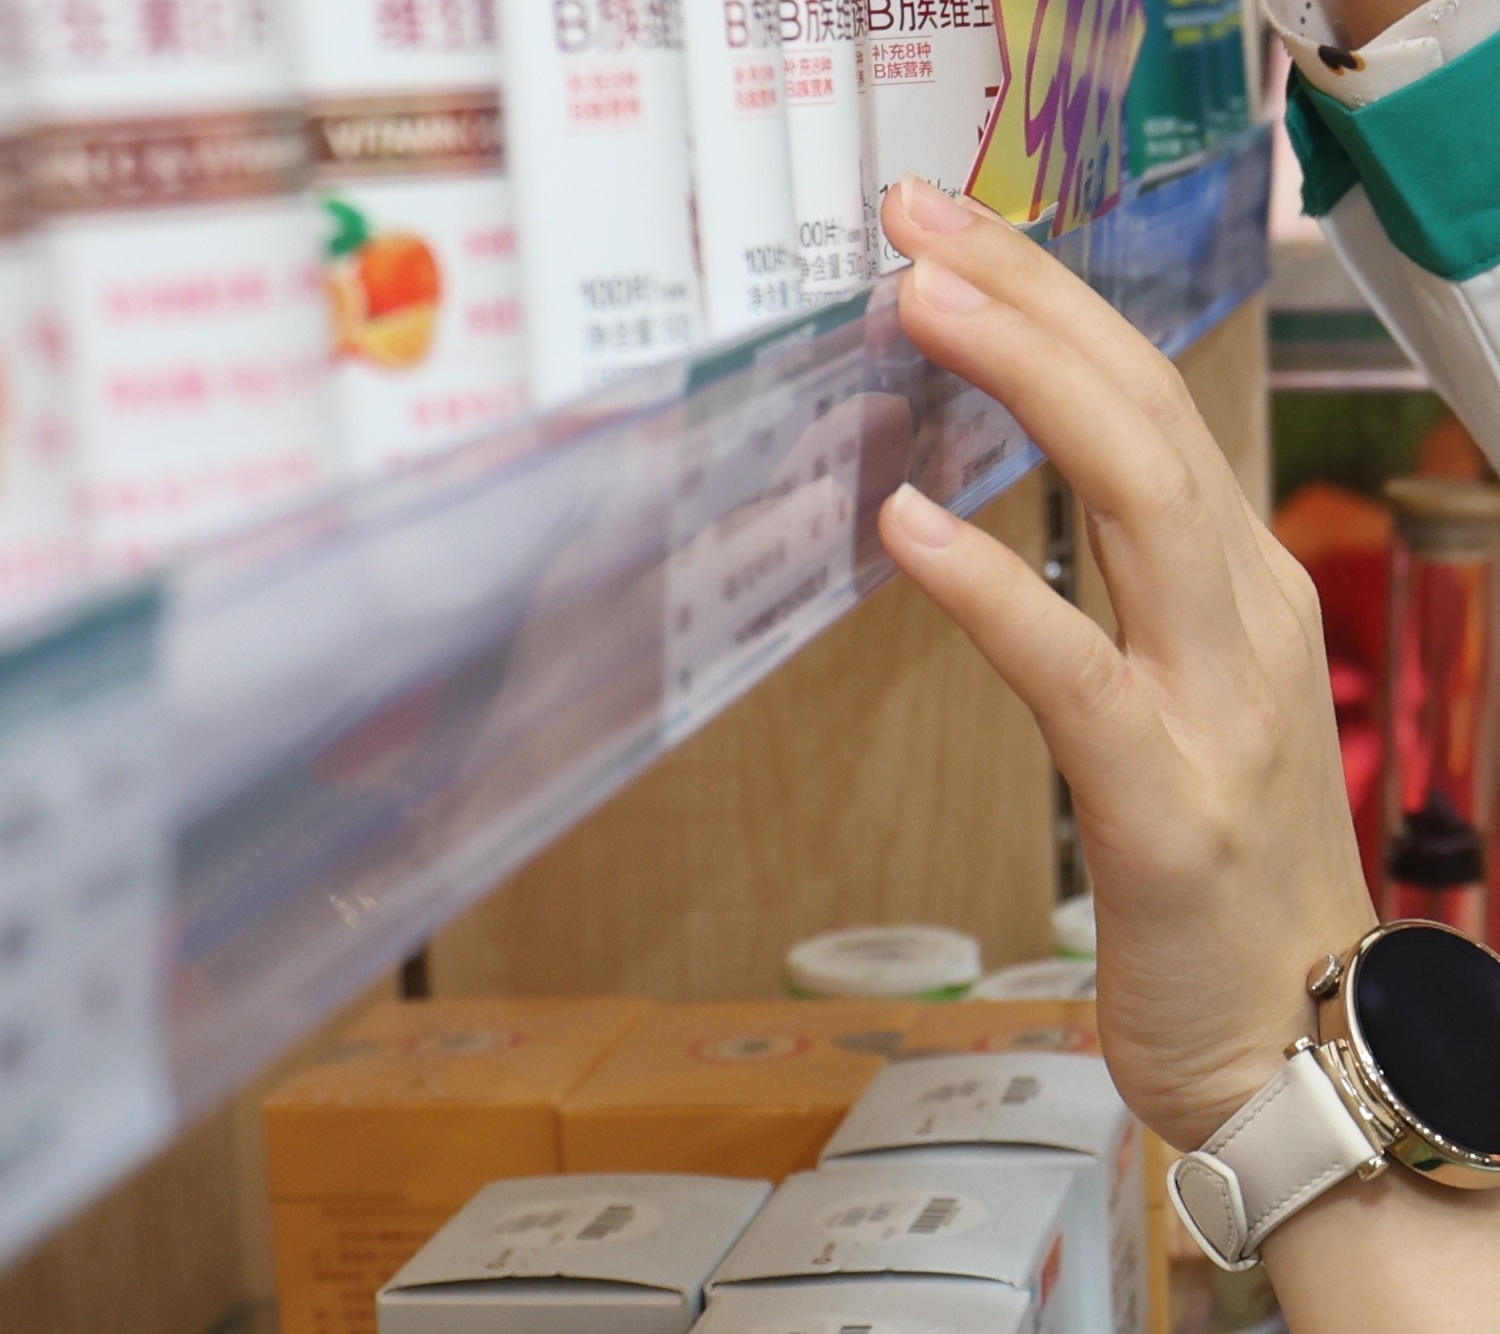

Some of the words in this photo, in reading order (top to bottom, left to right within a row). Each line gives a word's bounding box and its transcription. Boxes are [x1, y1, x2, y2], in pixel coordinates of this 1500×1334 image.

[872, 42, 931, 61] 补充8种
[873, 62, 934, 79] B族营养
